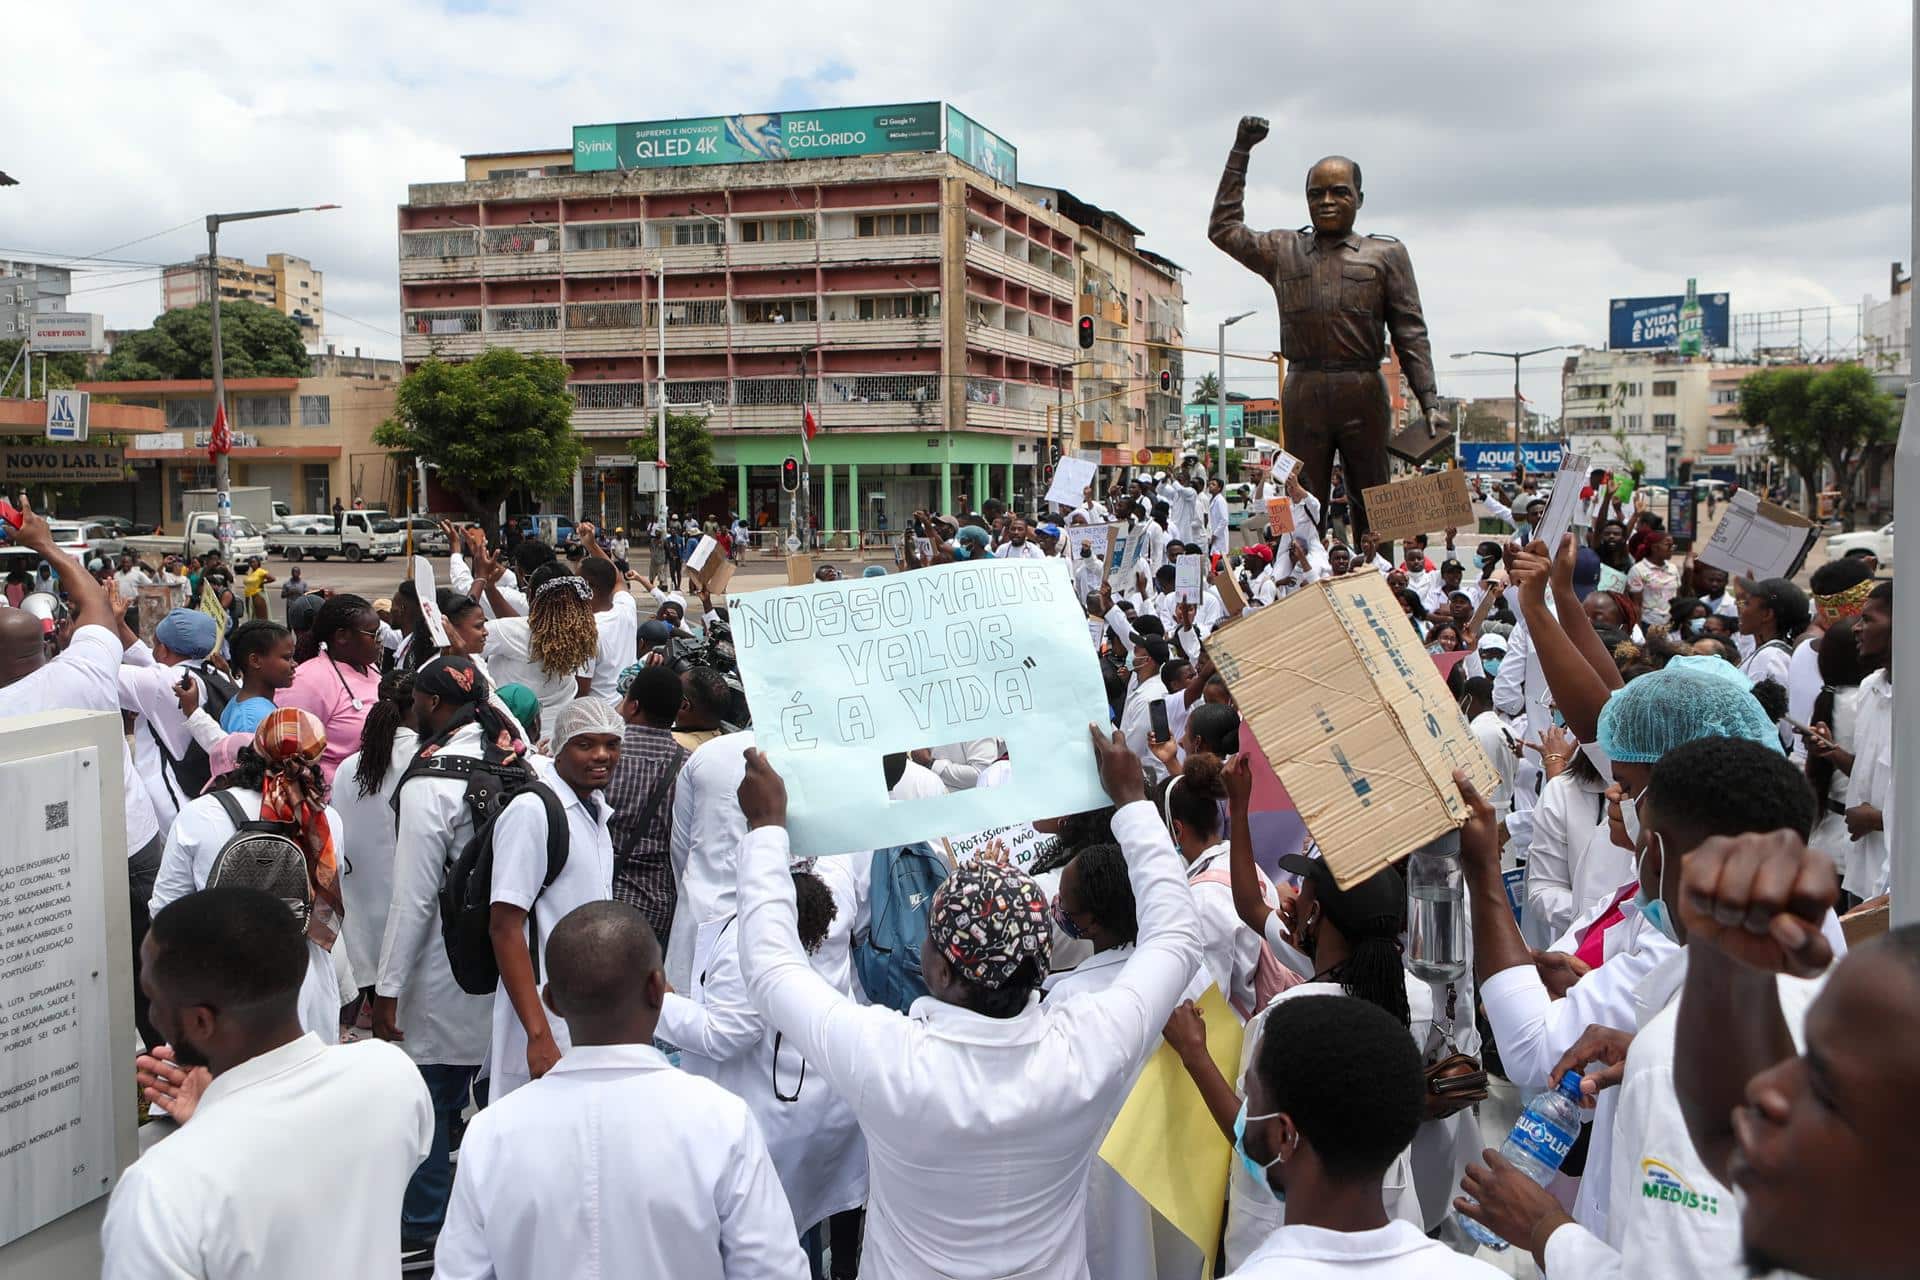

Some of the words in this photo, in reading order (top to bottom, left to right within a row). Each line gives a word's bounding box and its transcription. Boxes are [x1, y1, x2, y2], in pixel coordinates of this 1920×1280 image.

[636, 129, 671, 138] SUPREMO
[679, 126, 719, 134] INOVADOR
[788, 119, 824, 133] REAL
[577, 140, 613, 154] Syinix
[636, 138, 692, 158] QLED
[695, 136, 718, 154] 4K
[788, 131, 866, 148] COLORIDO
[1633, 319, 1643, 331] A
[1645, 312, 1677, 328] VIDA
[1644, 323, 1677, 340] UMA
[6, 453, 57, 468] NOVO
[1477, 451, 1516, 466] AQUA
[1525, 450, 1561, 463] PLUS
[729, 581, 912, 648] "NOSSO
[917, 566, 1054, 620] MAIOR
[837, 614, 1014, 686] VALOR
[780, 690, 818, 751] É
[837, 695, 876, 742] A
[899, 656, 1037, 730] VIDA"
[1013, 829, 1034, 847] NÃO
[16, 864, 25, 873] DE
[26, 853, 70, 870] INSURREIÇÃO
[1016, 849, 1031, 865] DO
[66, 880, 71, 888] A
[7, 923, 24, 933] PARA
[34, 909, 72, 925] CONQUISTA
[6, 940, 14, 949] DE
[67, 922, 73, 930] O
[7, 953, 23, 963] COM
[25, 950, 31, 958] A
[33, 936, 74, 955] LIQUIDAÇÃO
[8, 996, 24, 1008] LUTA
[47, 994, 69, 1008] SAÚDE
[5, 1036, 32, 1052] PORQUE
[38, 1031, 48, 1040] SEI
[53, 1023, 66, 1034] QUE
[11, 1027, 19, 1035] DE
[38, 1074, 48, 1083] DA
[50, 1062, 79, 1078] FRELIMO
[38, 1087, 49, 1098] FOI
[50, 1075, 80, 1092] REELEITO
[29, 1122, 67, 1144] MONDLANE
[70, 1117, 81, 1127] FOI
[72, 1163, 86, 1176] 5/5
[1642, 1182, 1700, 1209] MEDIS
